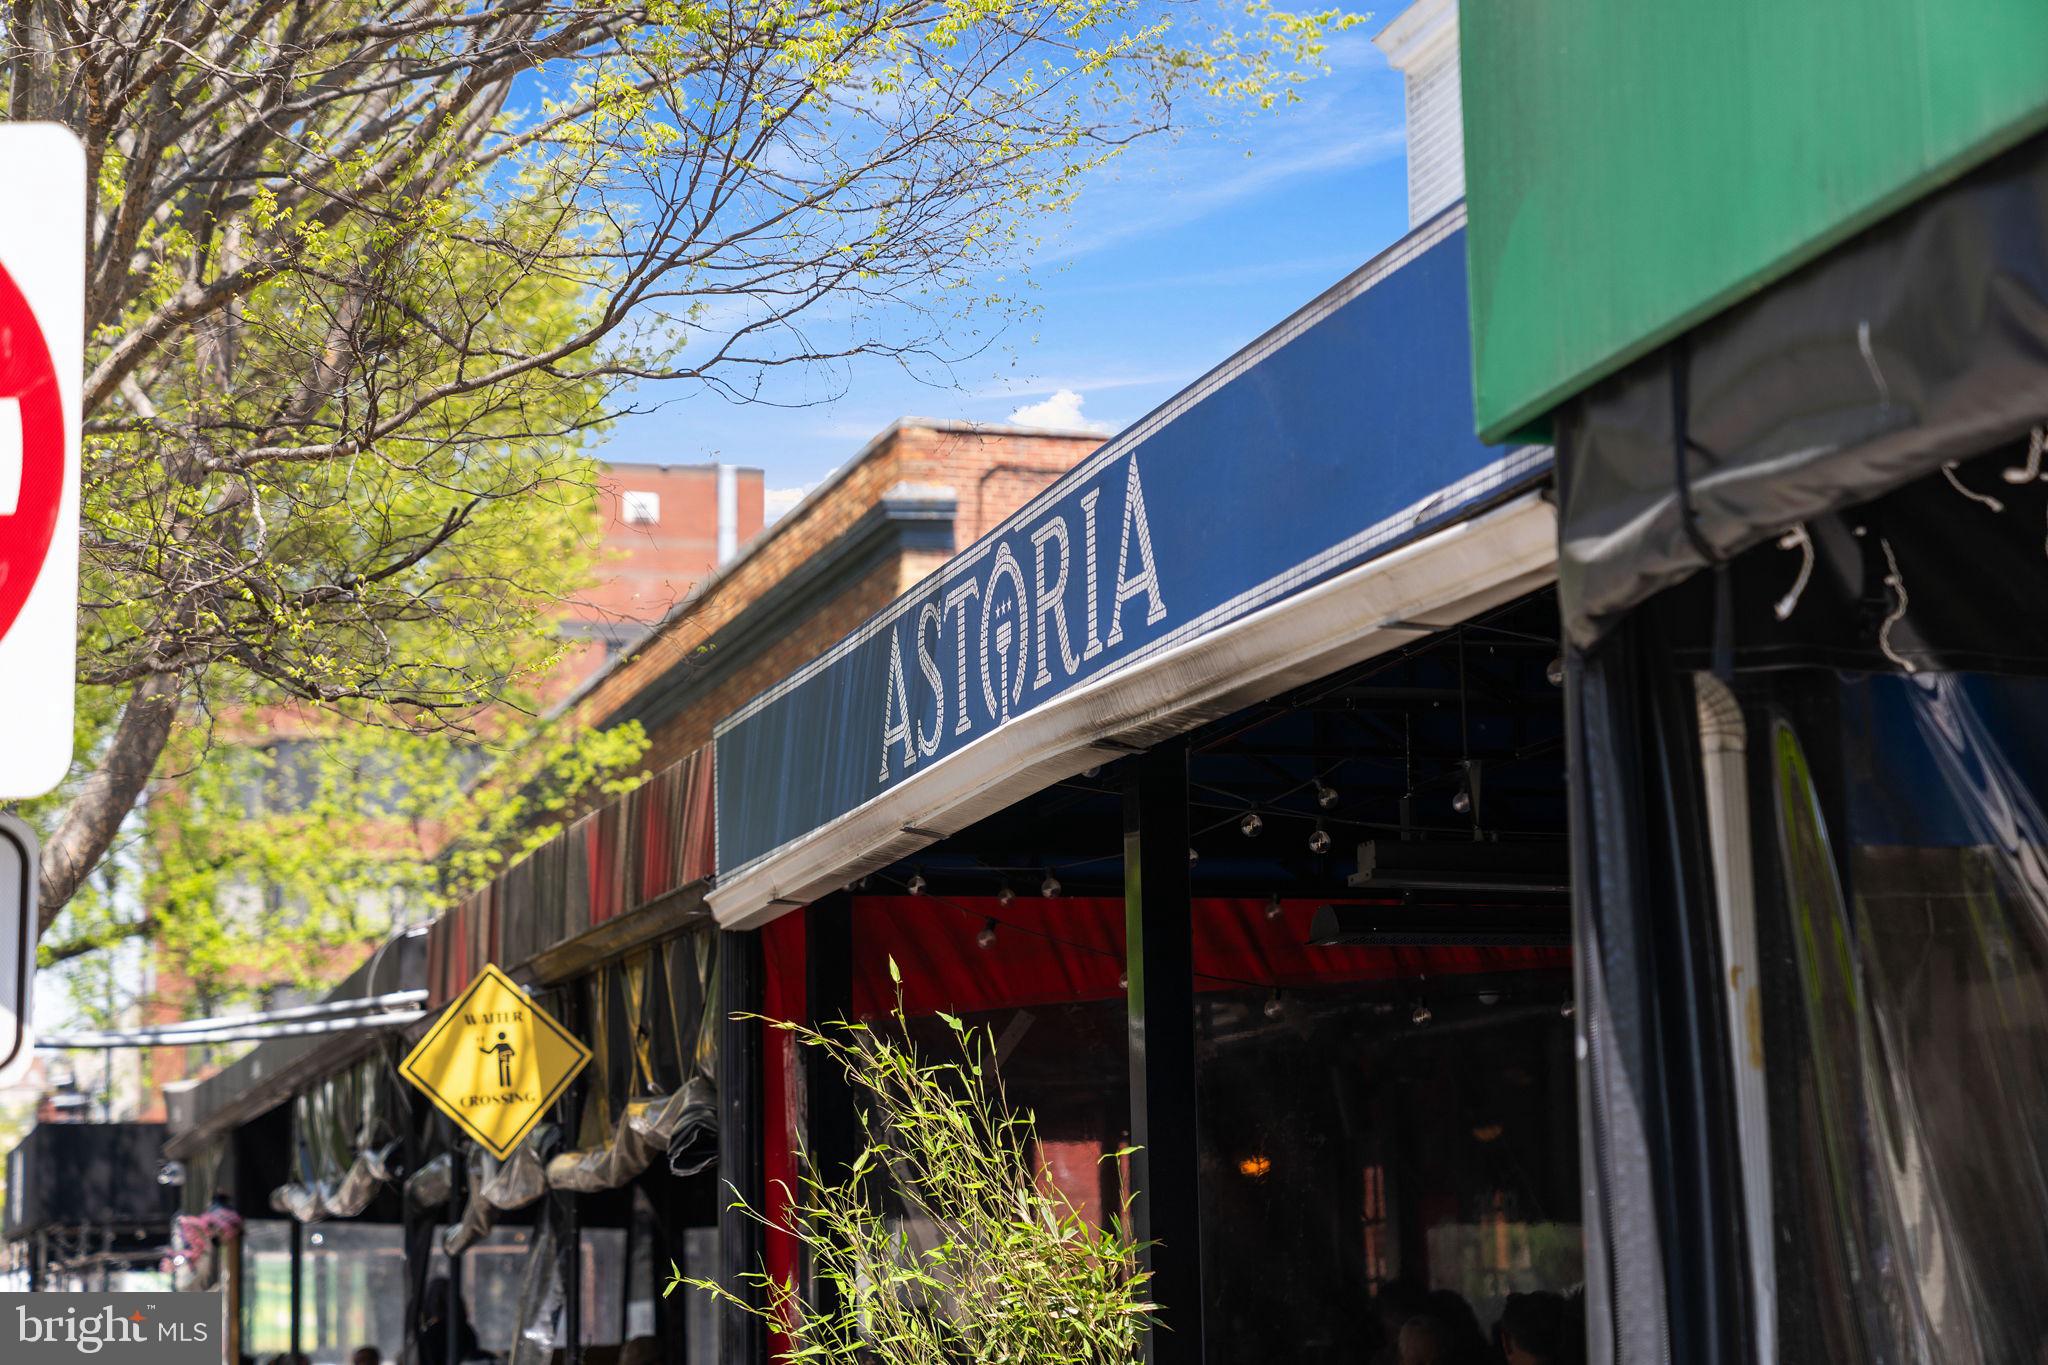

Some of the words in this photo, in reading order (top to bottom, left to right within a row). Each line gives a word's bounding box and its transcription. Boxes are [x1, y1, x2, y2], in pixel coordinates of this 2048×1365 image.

[879, 451, 1167, 782] ASTORIA
[464, 1012, 524, 1025] WAITER
[460, 1093, 535, 1107] CROSSING
